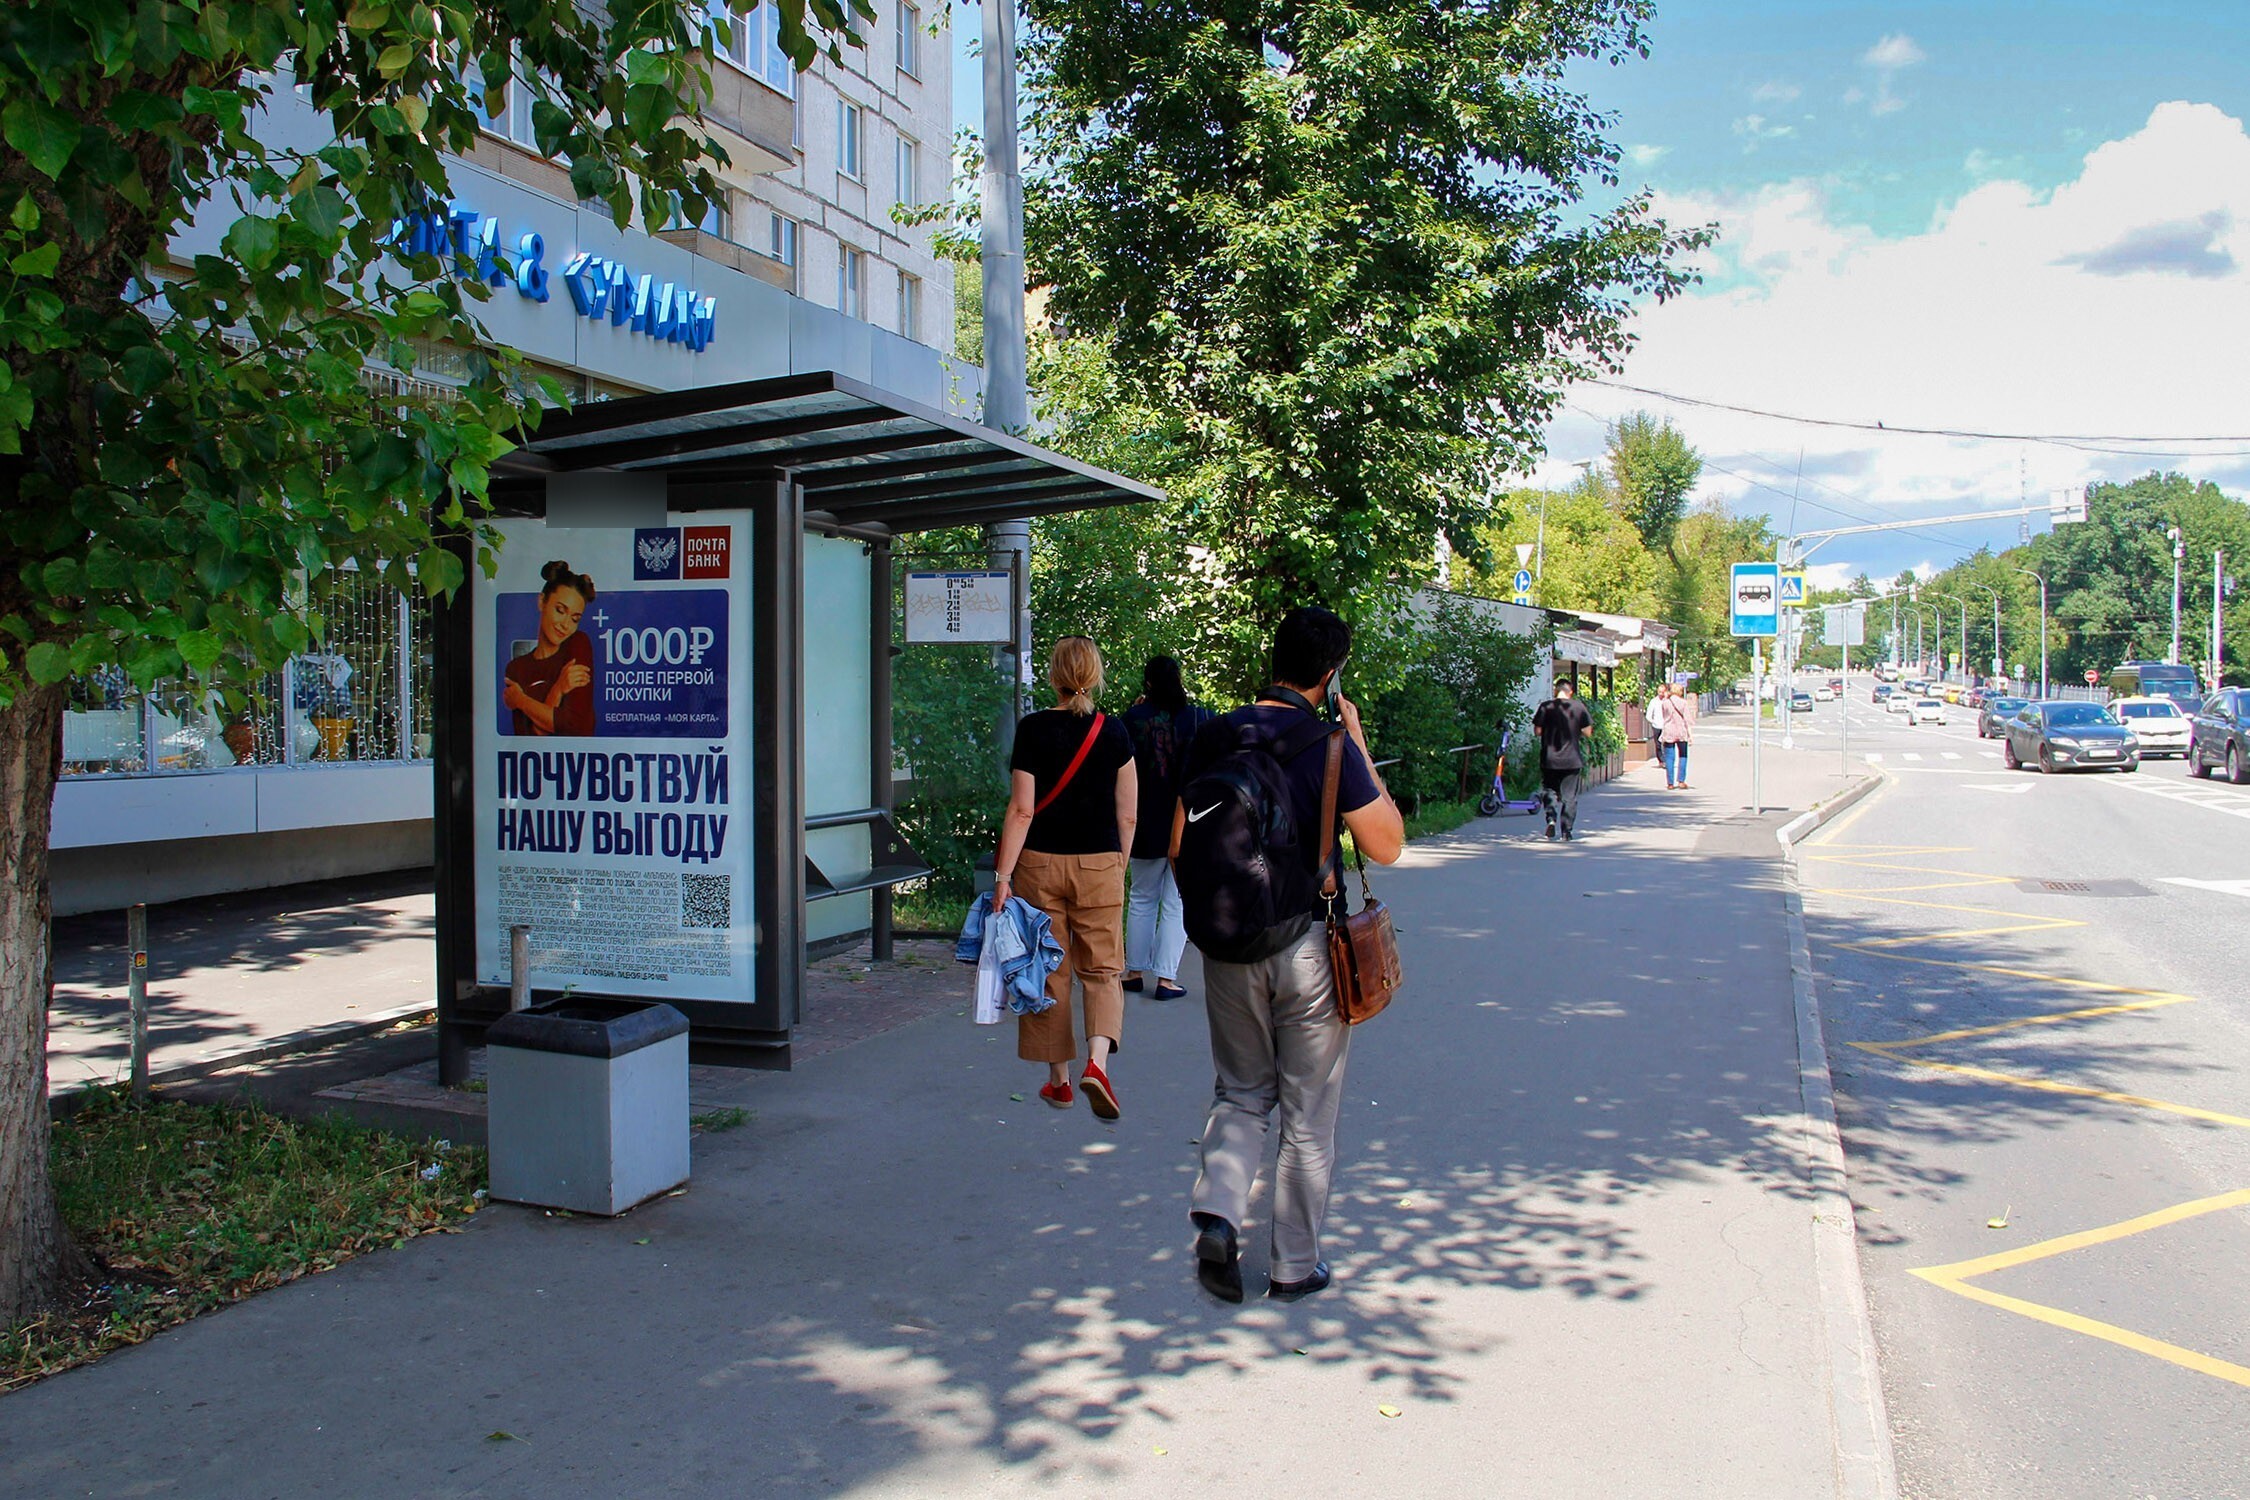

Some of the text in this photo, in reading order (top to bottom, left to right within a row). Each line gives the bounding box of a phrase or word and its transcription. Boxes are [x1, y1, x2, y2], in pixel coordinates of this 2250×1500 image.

[518, 233, 549, 303] &
[564, 252, 717, 352] СУВЛАКИ
[687, 538, 726, 552] ПОЧТА
[687, 554, 721, 568] БАНК
[605, 668, 714, 685] ПОСЛЕ ПЕРВОЙ
[605, 687, 672, 701] ПОКУПКИ
[605, 712, 719, 723] БЕСПЛАТНАЯ «МОЯ КАРТА»
[497, 746, 729, 805] ПОЧУВСТВУЙ
[497, 808, 729, 864] НАШУ ВЫГОДУ
